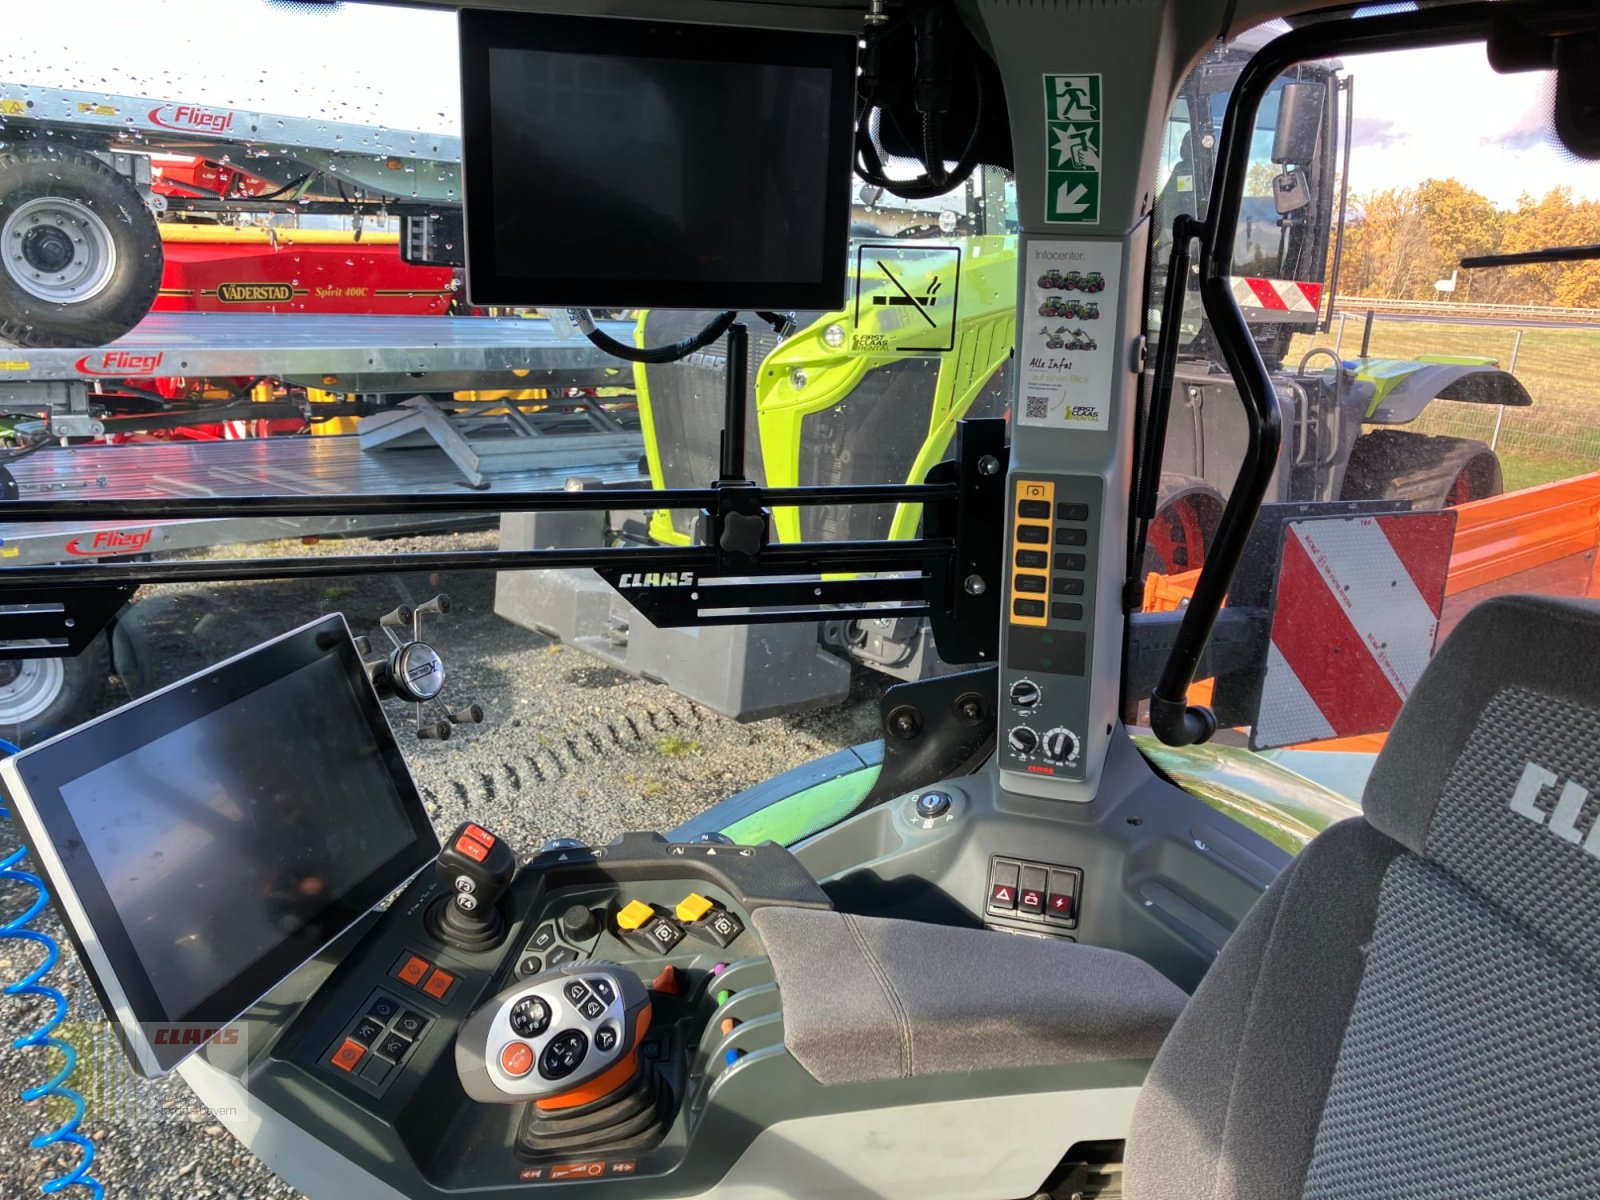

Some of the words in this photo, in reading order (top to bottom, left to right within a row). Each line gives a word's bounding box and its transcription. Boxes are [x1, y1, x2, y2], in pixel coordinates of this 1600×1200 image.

[174, 106, 233, 131] Fliegl
[222, 284, 289, 299] VÄDERSTAD
[315, 287, 342, 298] Spirit
[345, 287, 368, 297] 400C
[103, 352, 163, 371] Fliegl
[1029, 357, 1046, 369] Alle
[1047, 357, 1072, 373] Infos
[92, 528, 153, 551] Fliegl
[619, 572, 694, 588] CLAAS
[458, 881, 472, 892] F3
[459, 898, 473, 909] F4
